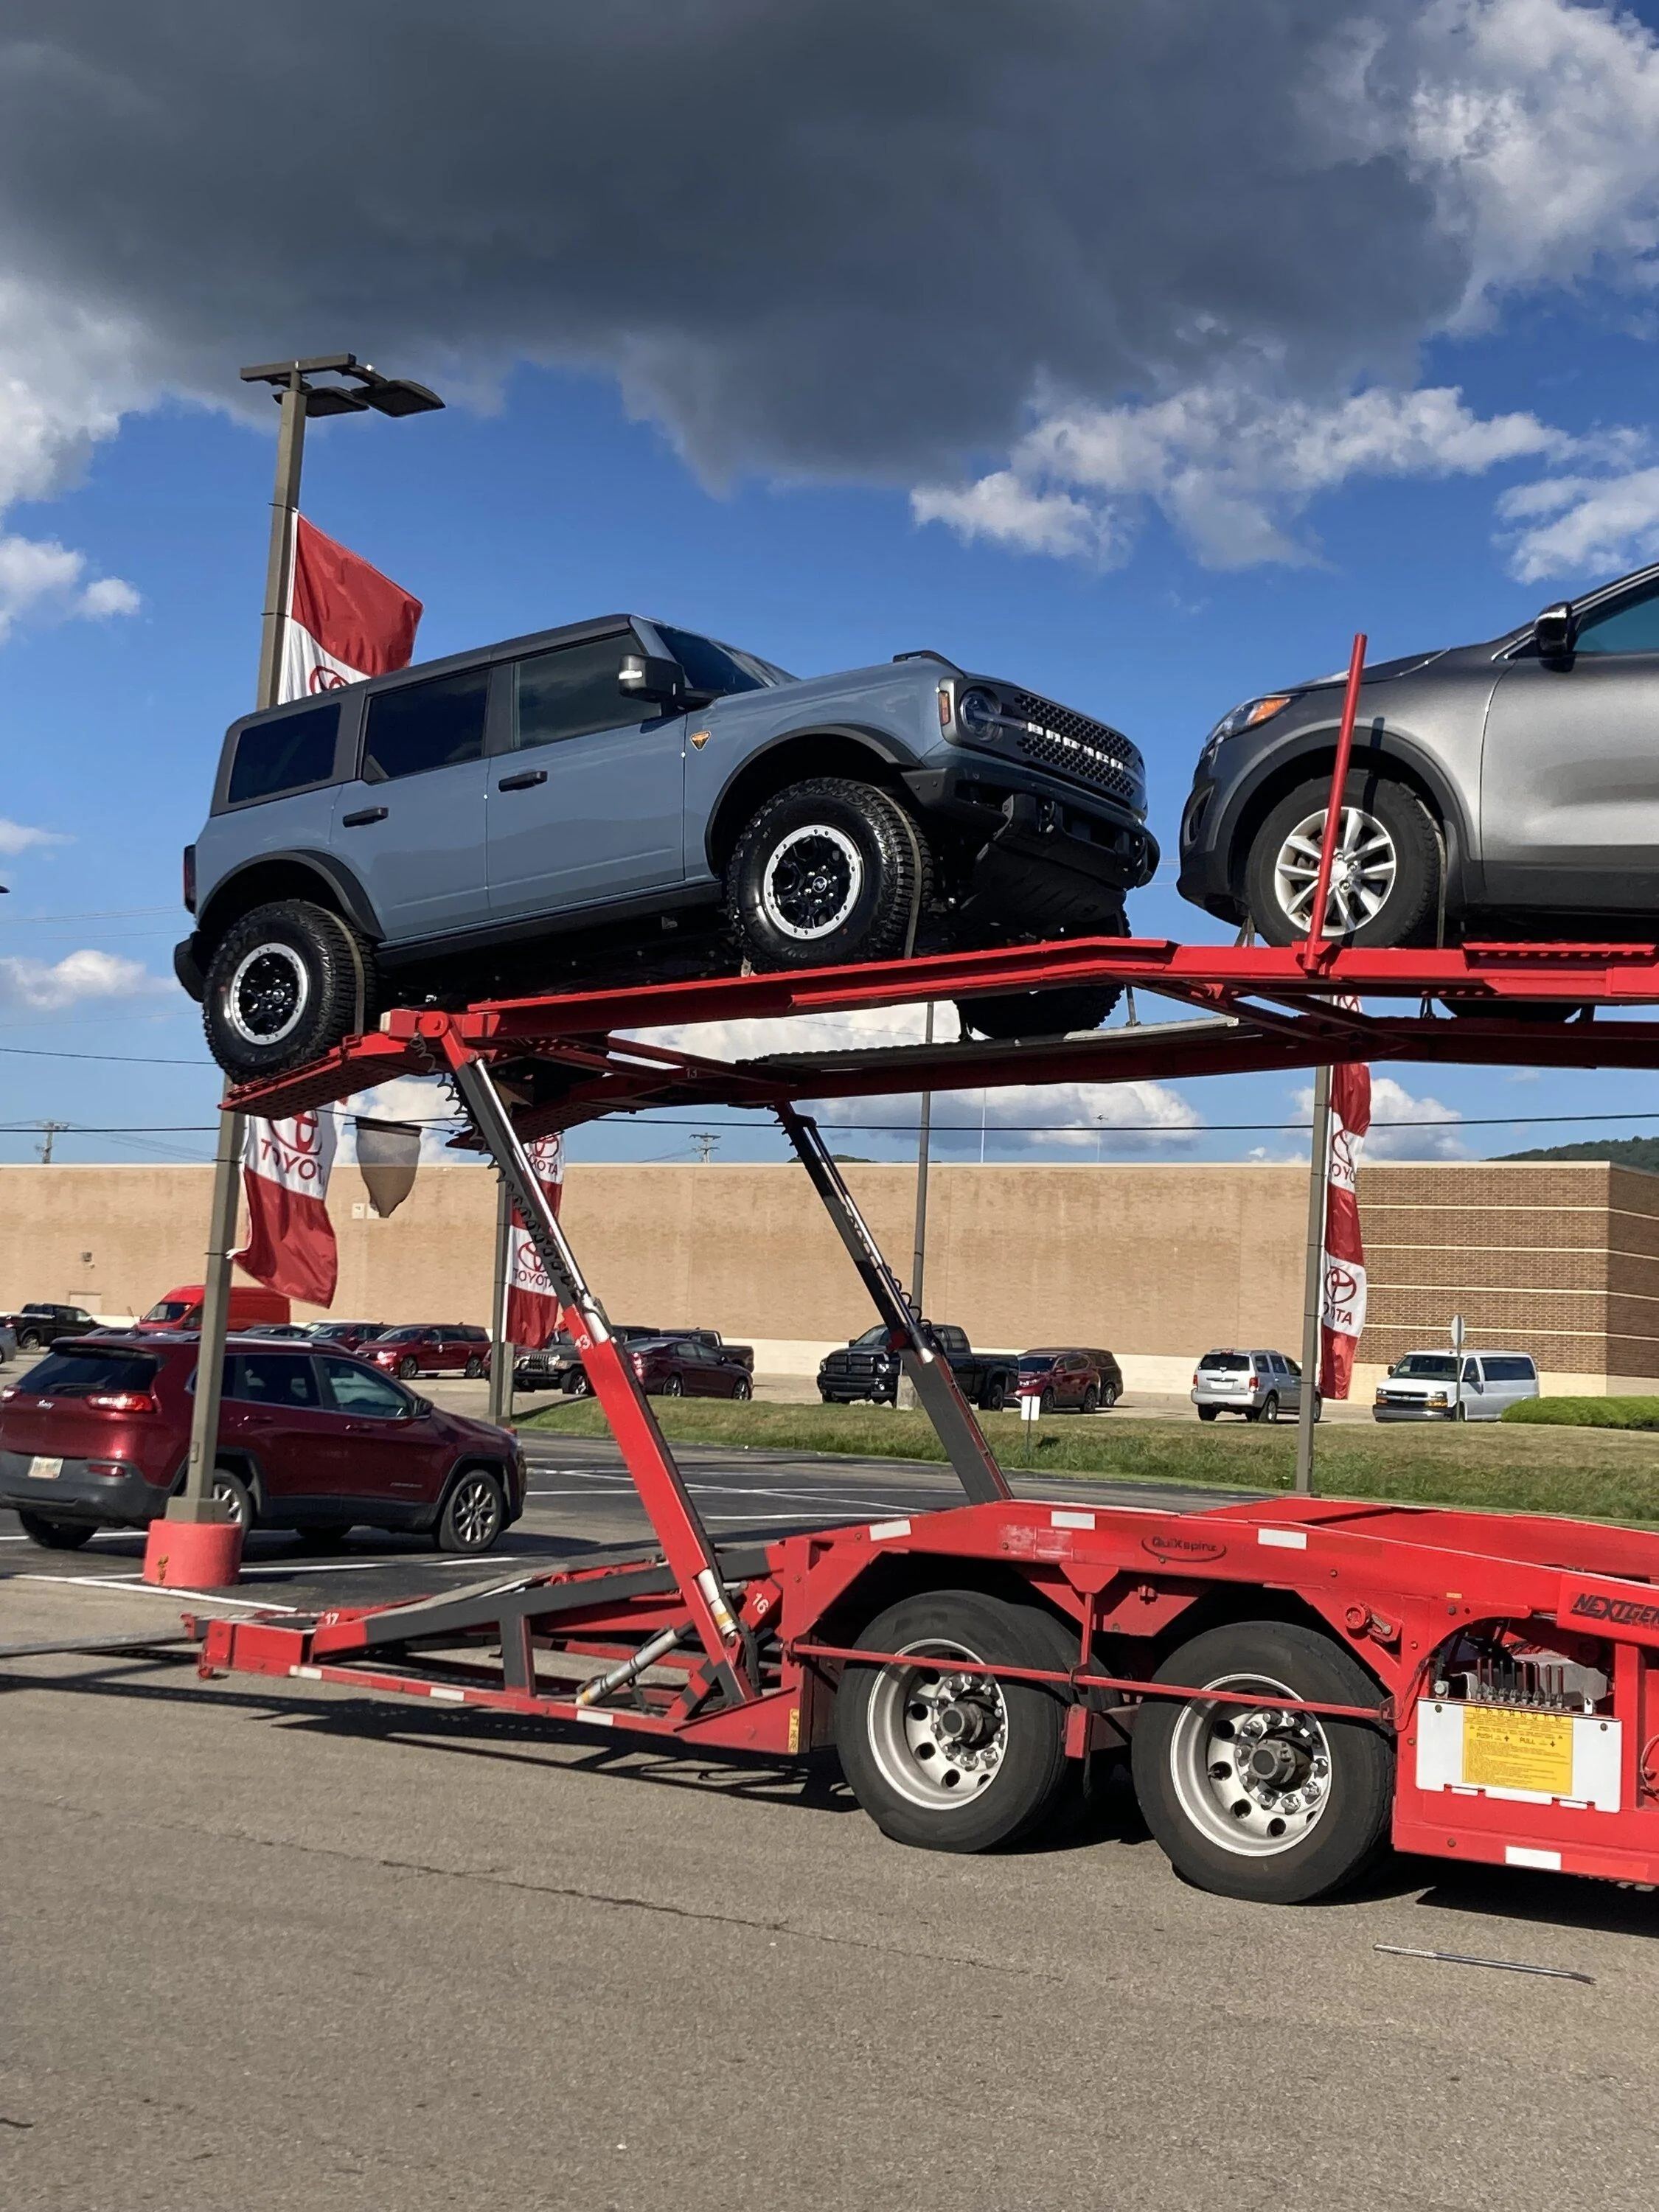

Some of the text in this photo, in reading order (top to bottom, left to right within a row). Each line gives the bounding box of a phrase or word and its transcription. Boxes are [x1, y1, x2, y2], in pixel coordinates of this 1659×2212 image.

[1027, 722, 1124, 771] BRONCO
[260, 1138, 323, 1184] TOYOT
[325, 1612, 340, 1625] 17
[752, 1592, 769, 1615] 16
[1570, 1593, 1659, 1625] NEXTGE
